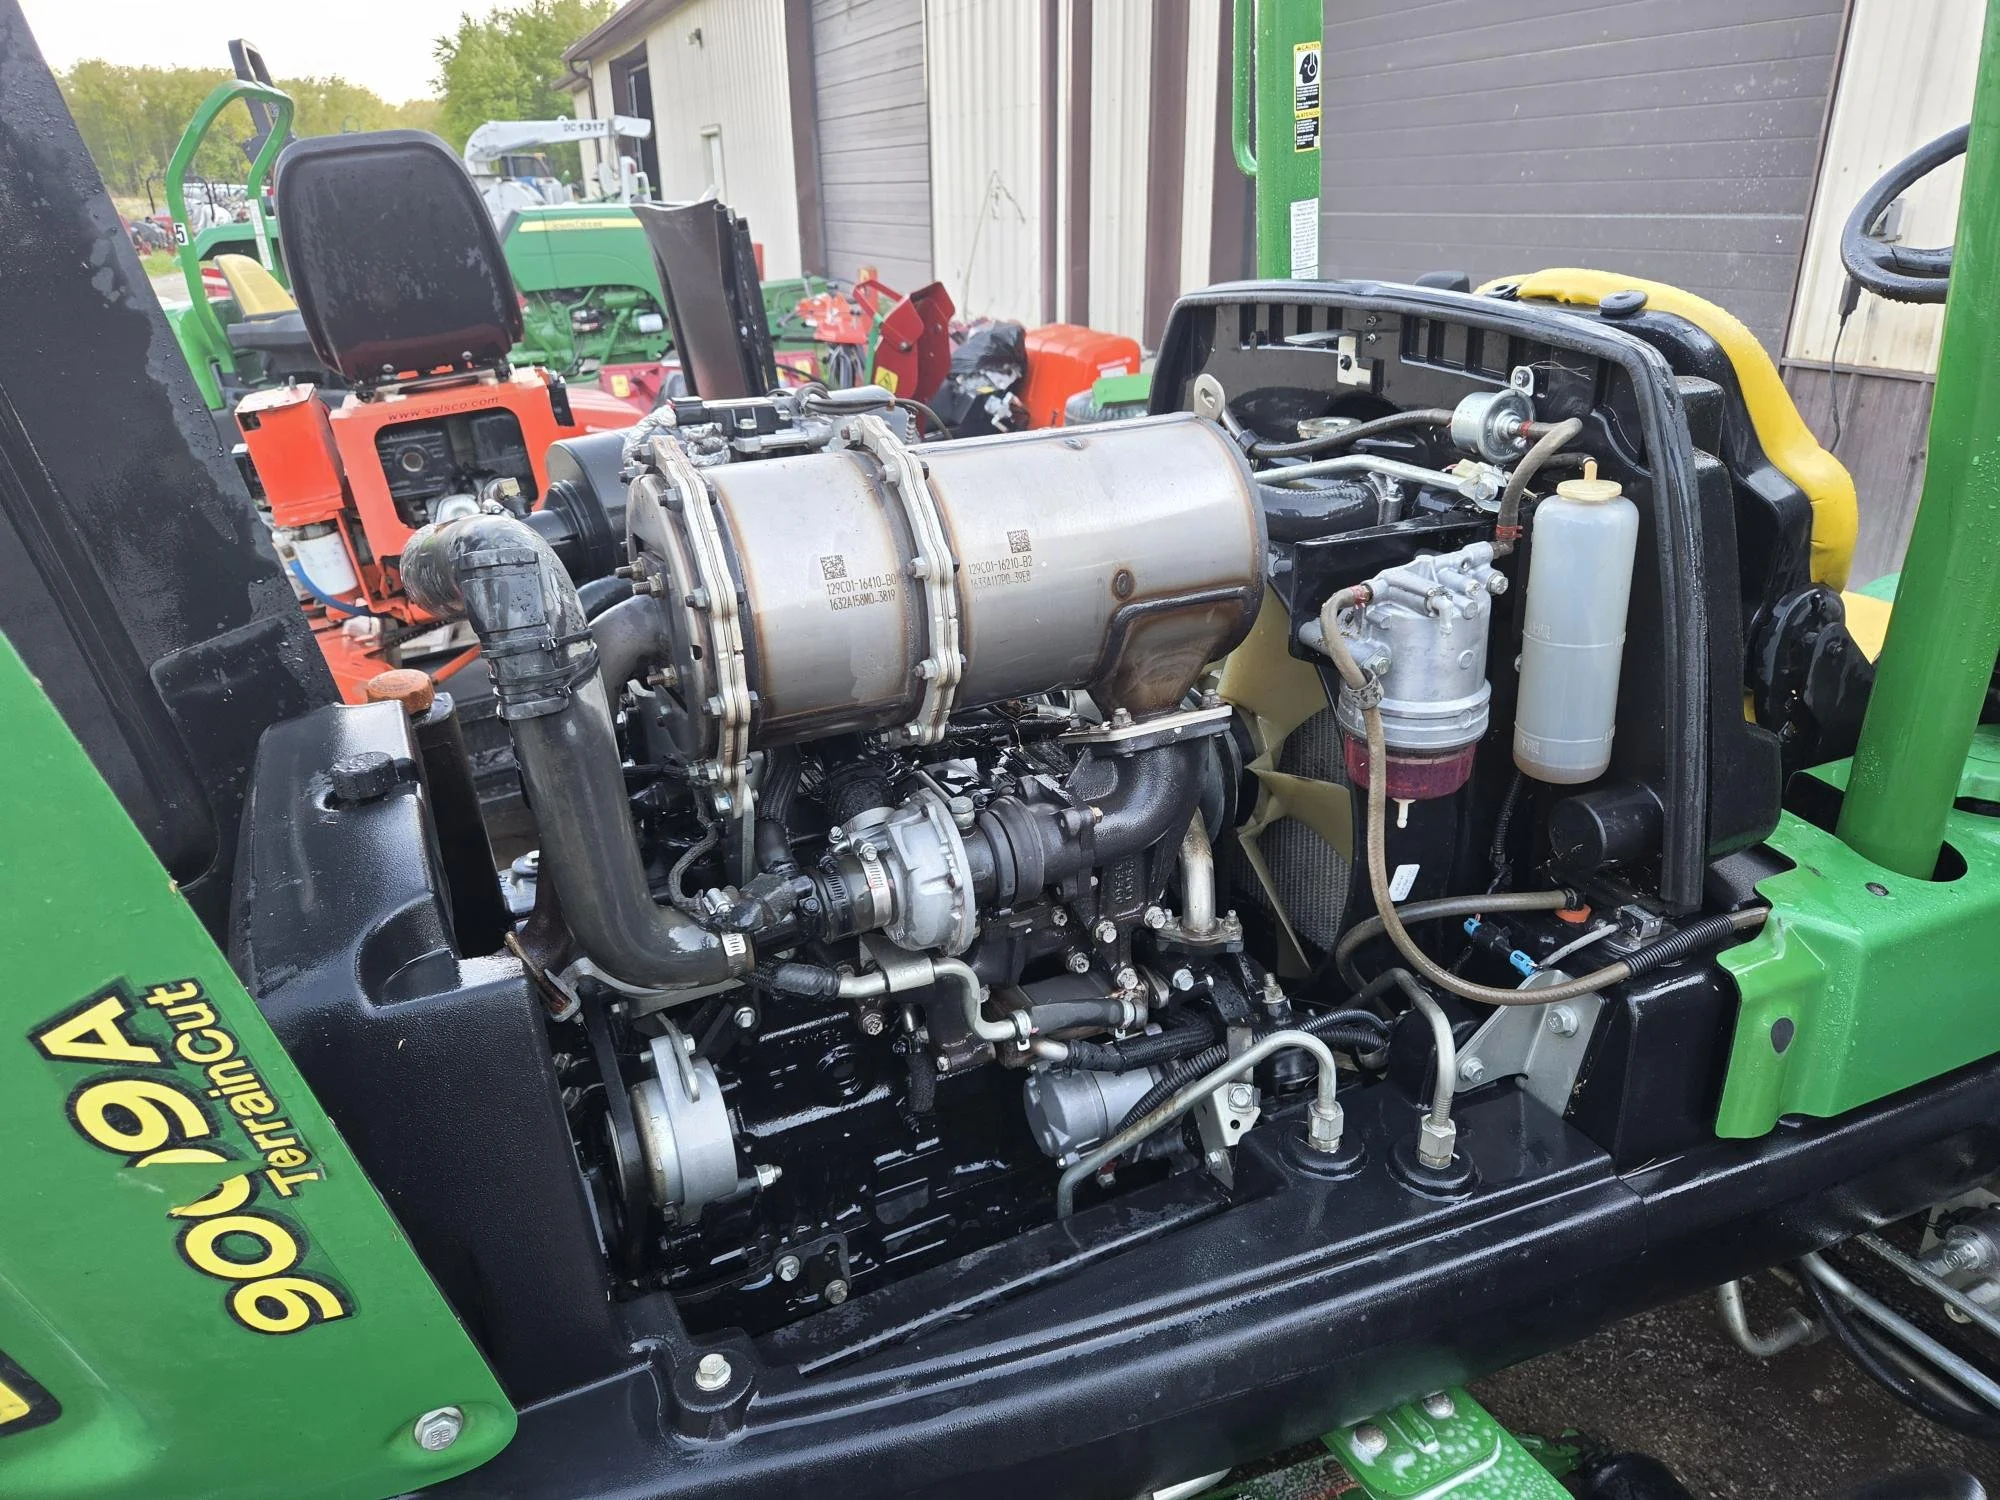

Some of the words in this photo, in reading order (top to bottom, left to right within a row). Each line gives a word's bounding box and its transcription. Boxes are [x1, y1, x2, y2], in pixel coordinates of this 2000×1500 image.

[579, 123, 605, 131] 1317
[175, 224, 186, 243] 5
[388, 397, 499, 420] www.salsco.com
[145, 980, 319, 1198] TerrainCut
